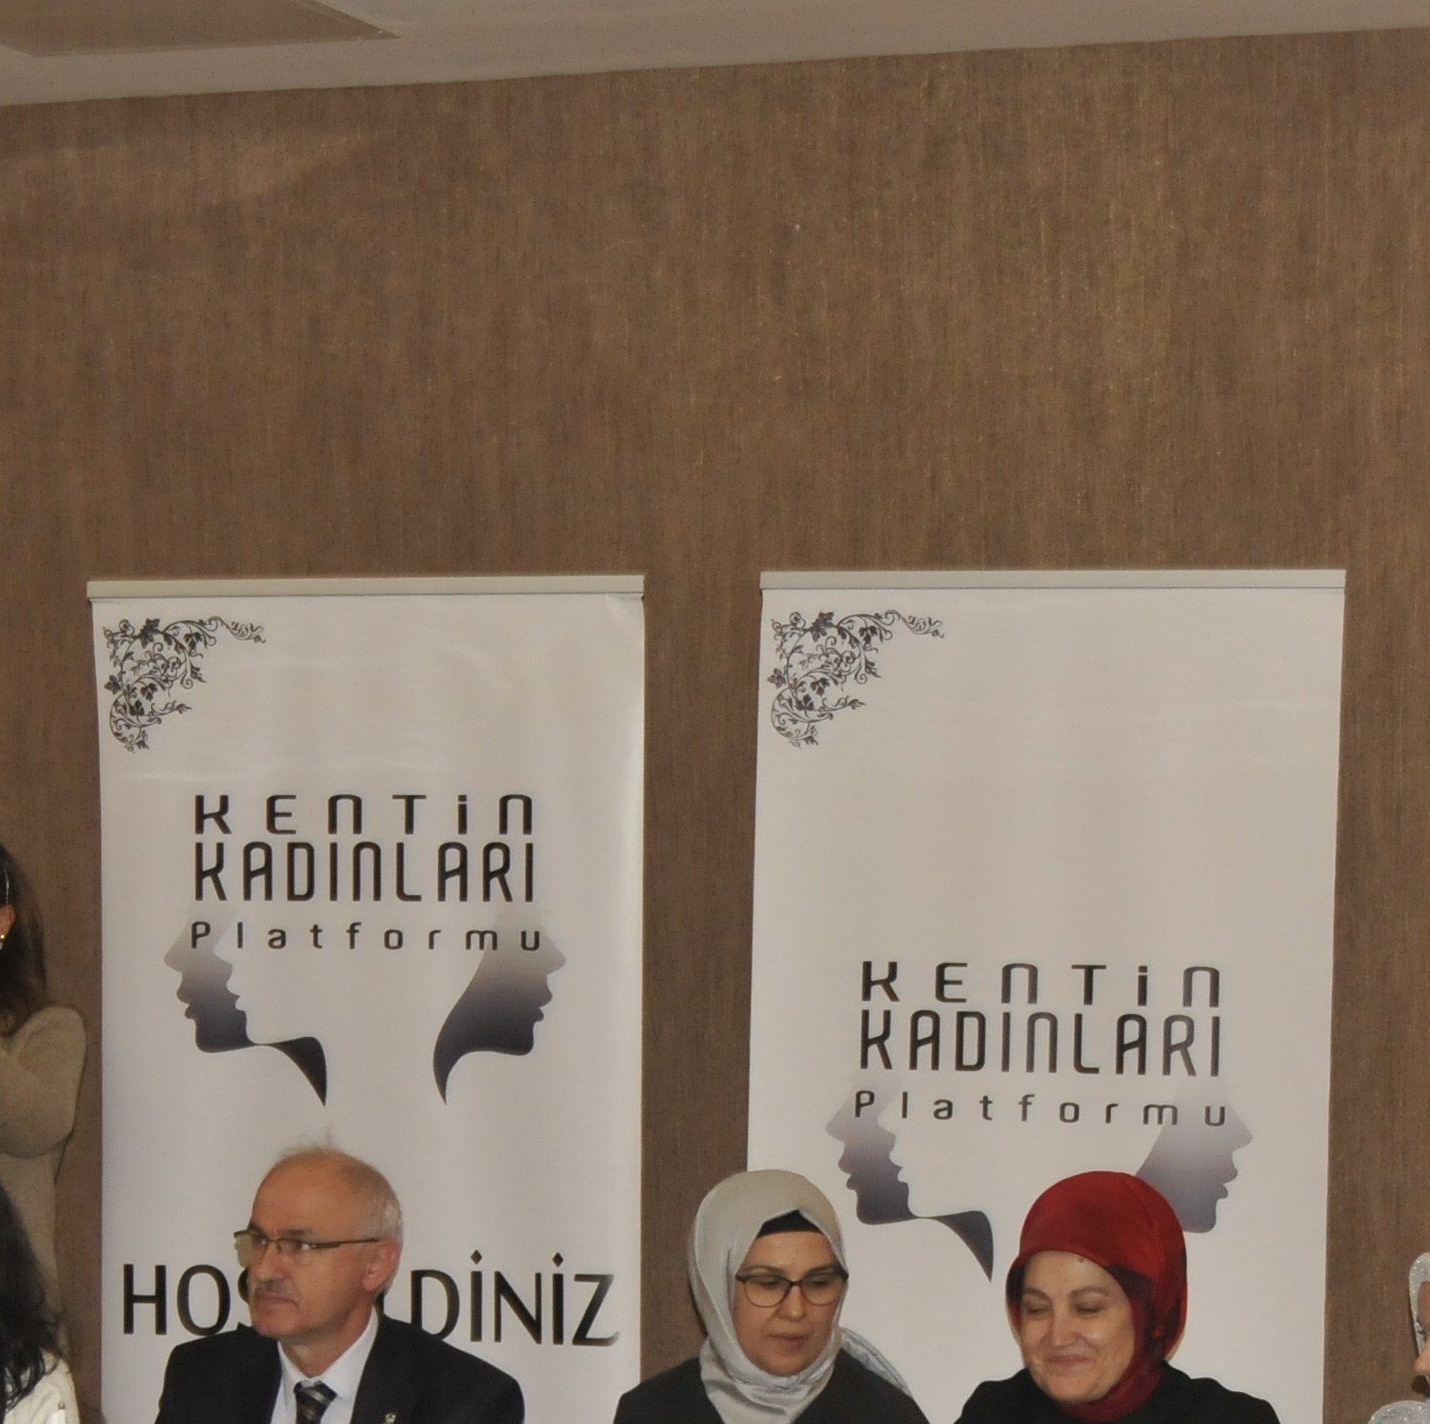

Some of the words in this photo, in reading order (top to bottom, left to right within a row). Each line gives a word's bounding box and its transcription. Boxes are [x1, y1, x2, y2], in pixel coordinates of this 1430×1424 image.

[194, 841, 534, 902] KADINLARI
[190, 921, 541, 952] Platformu
[860, 1009, 1221, 1077] KADINLARI
[854, 1090, 1227, 1128] Platformu
